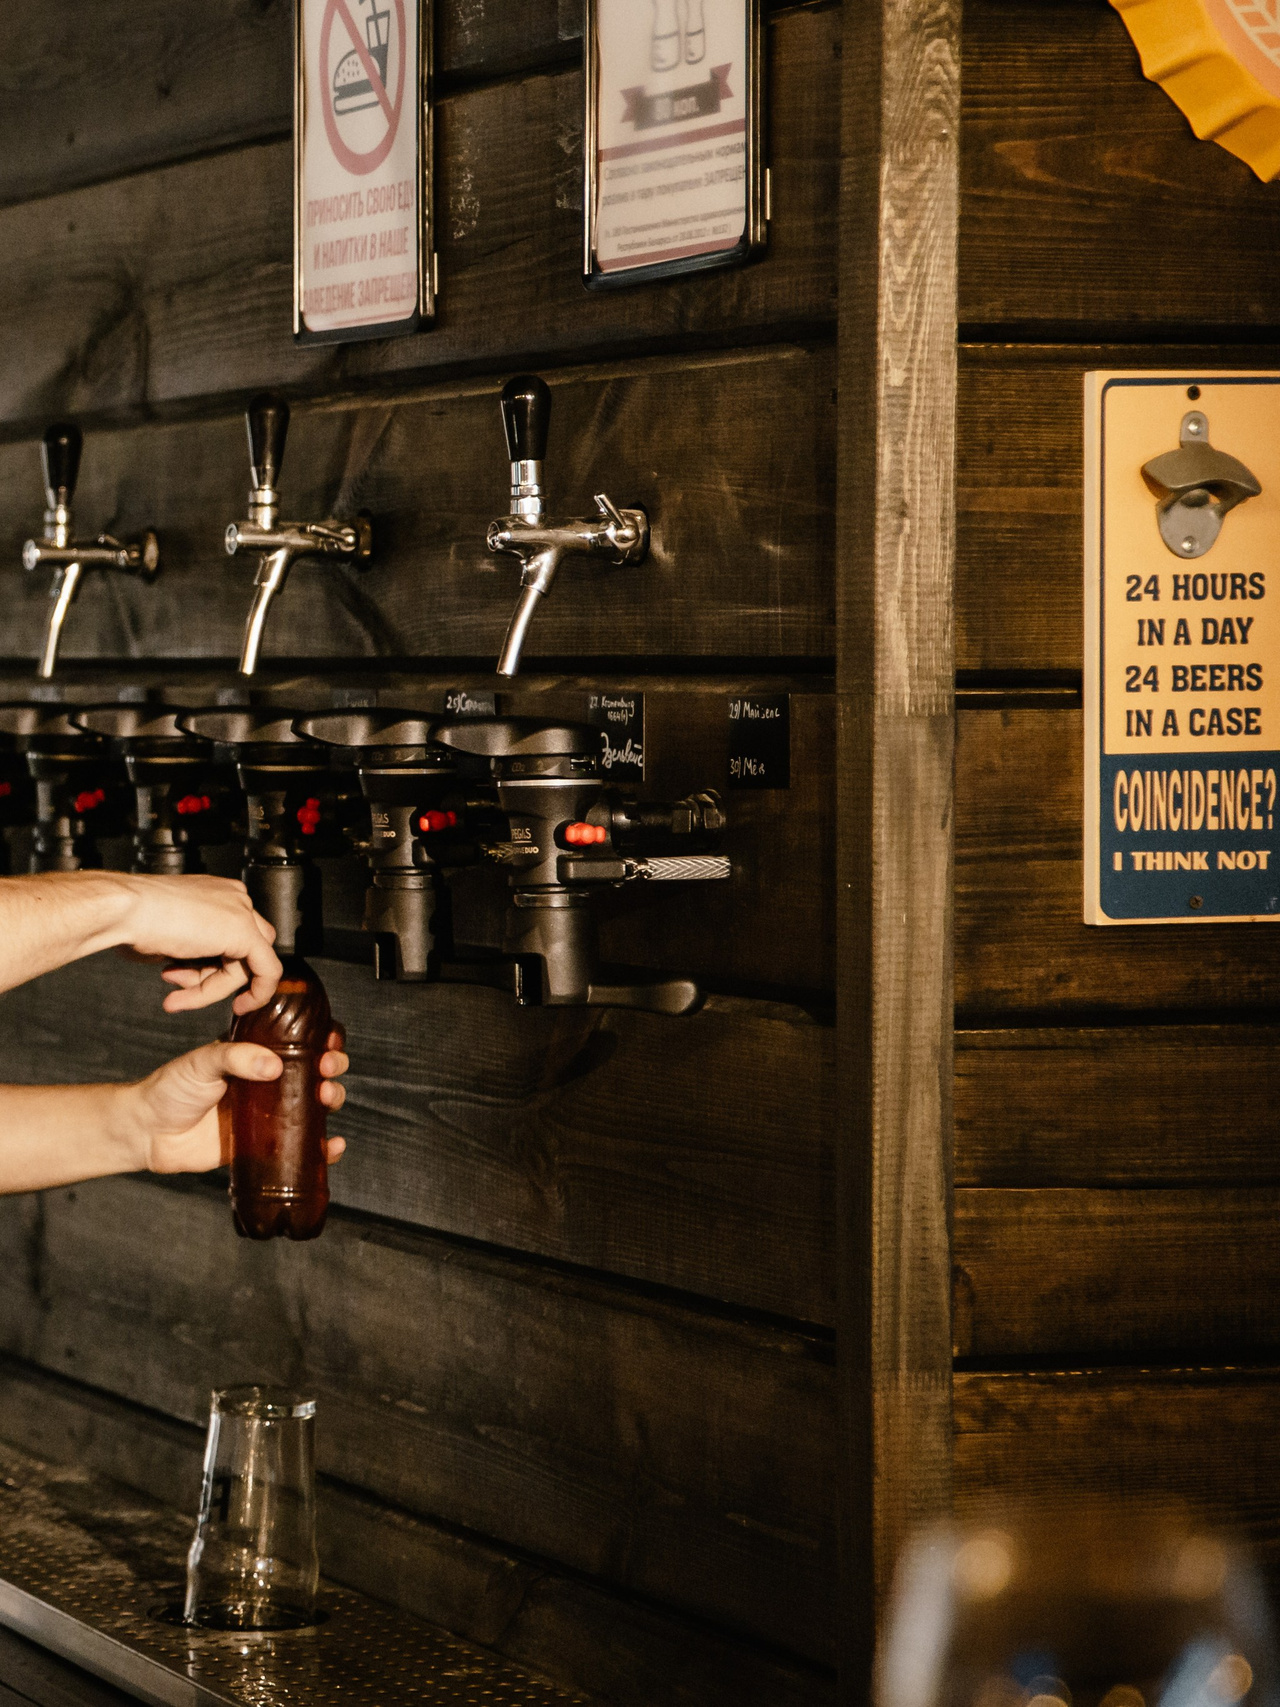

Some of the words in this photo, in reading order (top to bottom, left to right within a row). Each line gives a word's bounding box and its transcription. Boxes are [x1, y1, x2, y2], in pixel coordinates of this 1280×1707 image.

[306, 190, 363, 228] ПРИНОСИТЬ
[366, 183, 396, 216] СВОЮ
[398, 178, 415, 212] ЕДУ
[313, 243, 320, 270] И
[322, 235, 367, 269] НАПИТКИ
[370, 233, 377, 261] В
[379, 226, 409, 259] НАШЕ
[358, 271, 417, 307] ЗАПРЕЩЕН
[1126, 574, 1160, 601] 24
[1172, 572, 1266, 601] HOURS
[1137, 618, 1166, 646] IN
[1173, 618, 1192, 646] A
[1201, 616, 1254, 645] DAY
[1125, 665, 1160, 693] 24
[1171, 662, 1263, 692] BEERS
[1126, 709, 1153, 737] IN
[1162, 708, 1180, 737] A
[1189, 707, 1262, 736] CASE
[1113, 768, 1277, 832] COINCIDENCE?
[1113, 851, 1123, 871] I
[1131, 850, 1209, 871] THINK
[1217, 850, 1272, 870] NOT
